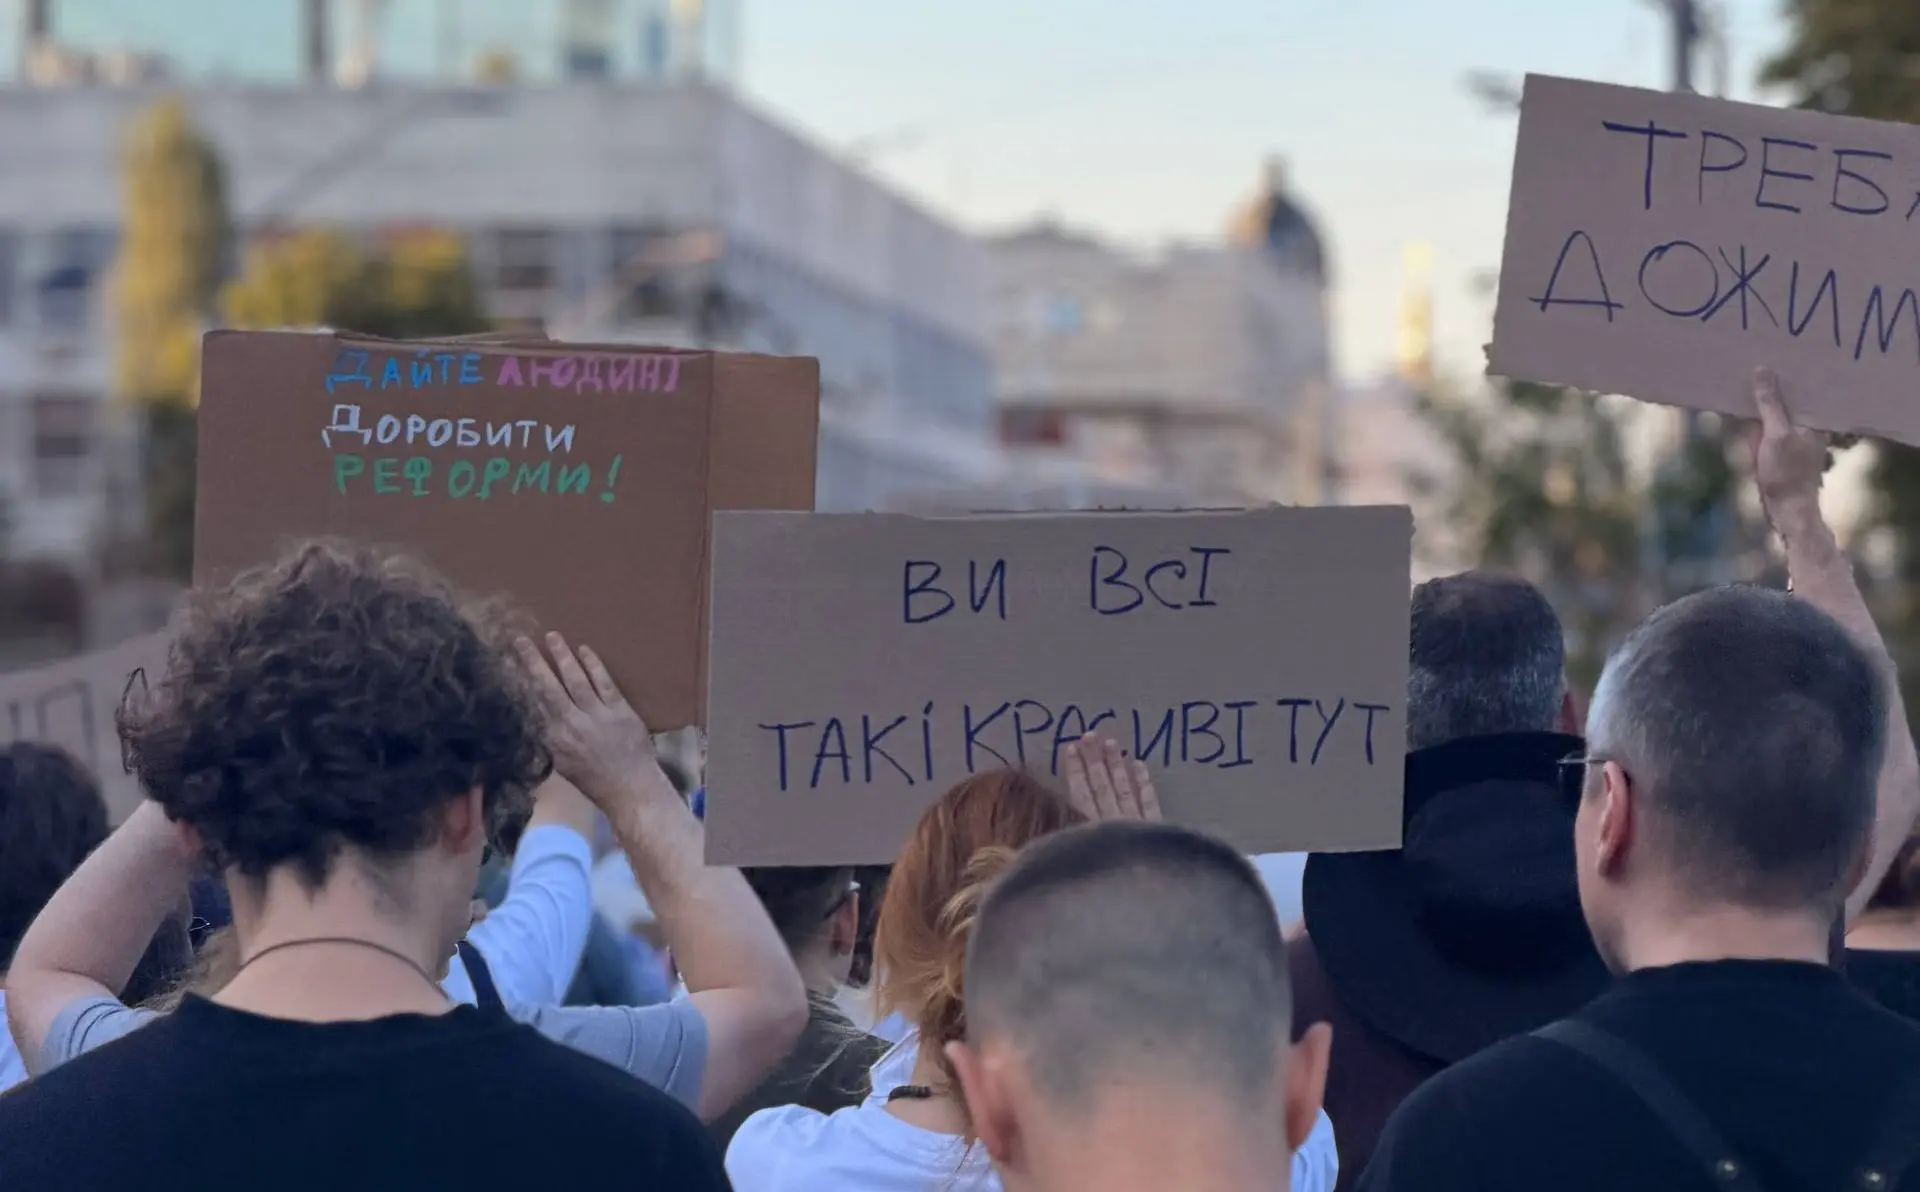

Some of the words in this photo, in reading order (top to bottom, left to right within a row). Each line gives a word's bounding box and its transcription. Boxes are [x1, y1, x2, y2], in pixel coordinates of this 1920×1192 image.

[1602, 120, 1920, 220] ТРЕБ
[1528, 229, 1920, 362] ДОЖИМ
[325, 348, 485, 394] ДАЙТЕ
[321, 403, 577, 454] ДОРОБИТИ
[334, 453, 623, 504] РЕФОРМИ!
[903, 558, 1007, 624] ВИ
[1090, 545, 1231, 616] ВСІ
[758, 700, 934, 792] ТАКІ
[1276, 697, 1390, 766] ТУТ
